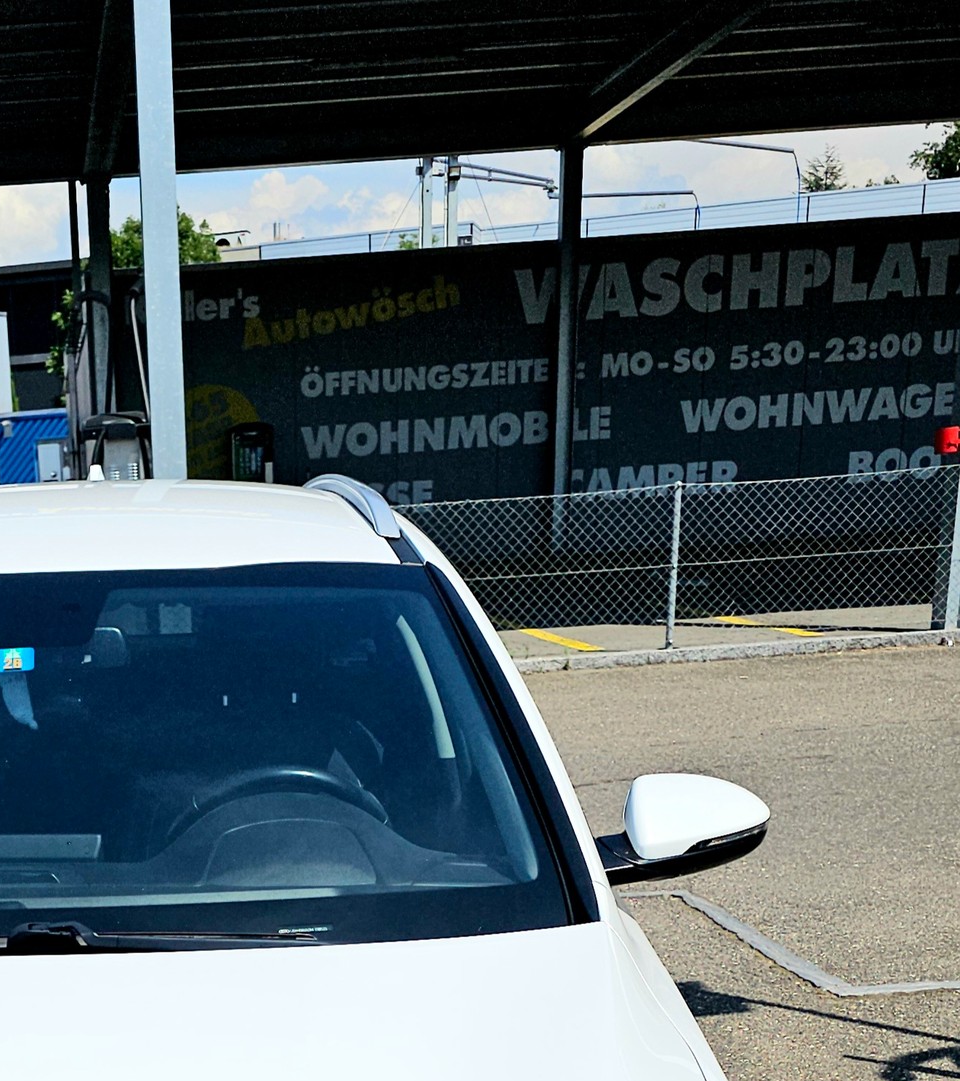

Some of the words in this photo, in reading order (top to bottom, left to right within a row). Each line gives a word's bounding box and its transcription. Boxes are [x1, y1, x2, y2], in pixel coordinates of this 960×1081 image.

[242, 275, 461, 351] Autowösch
[513, 238, 960, 325] WASCHPLAT
[300, 357, 586, 399] ÖFFNUNGSZEITE:
[300, 405, 612, 460] WOHNMOBLE
